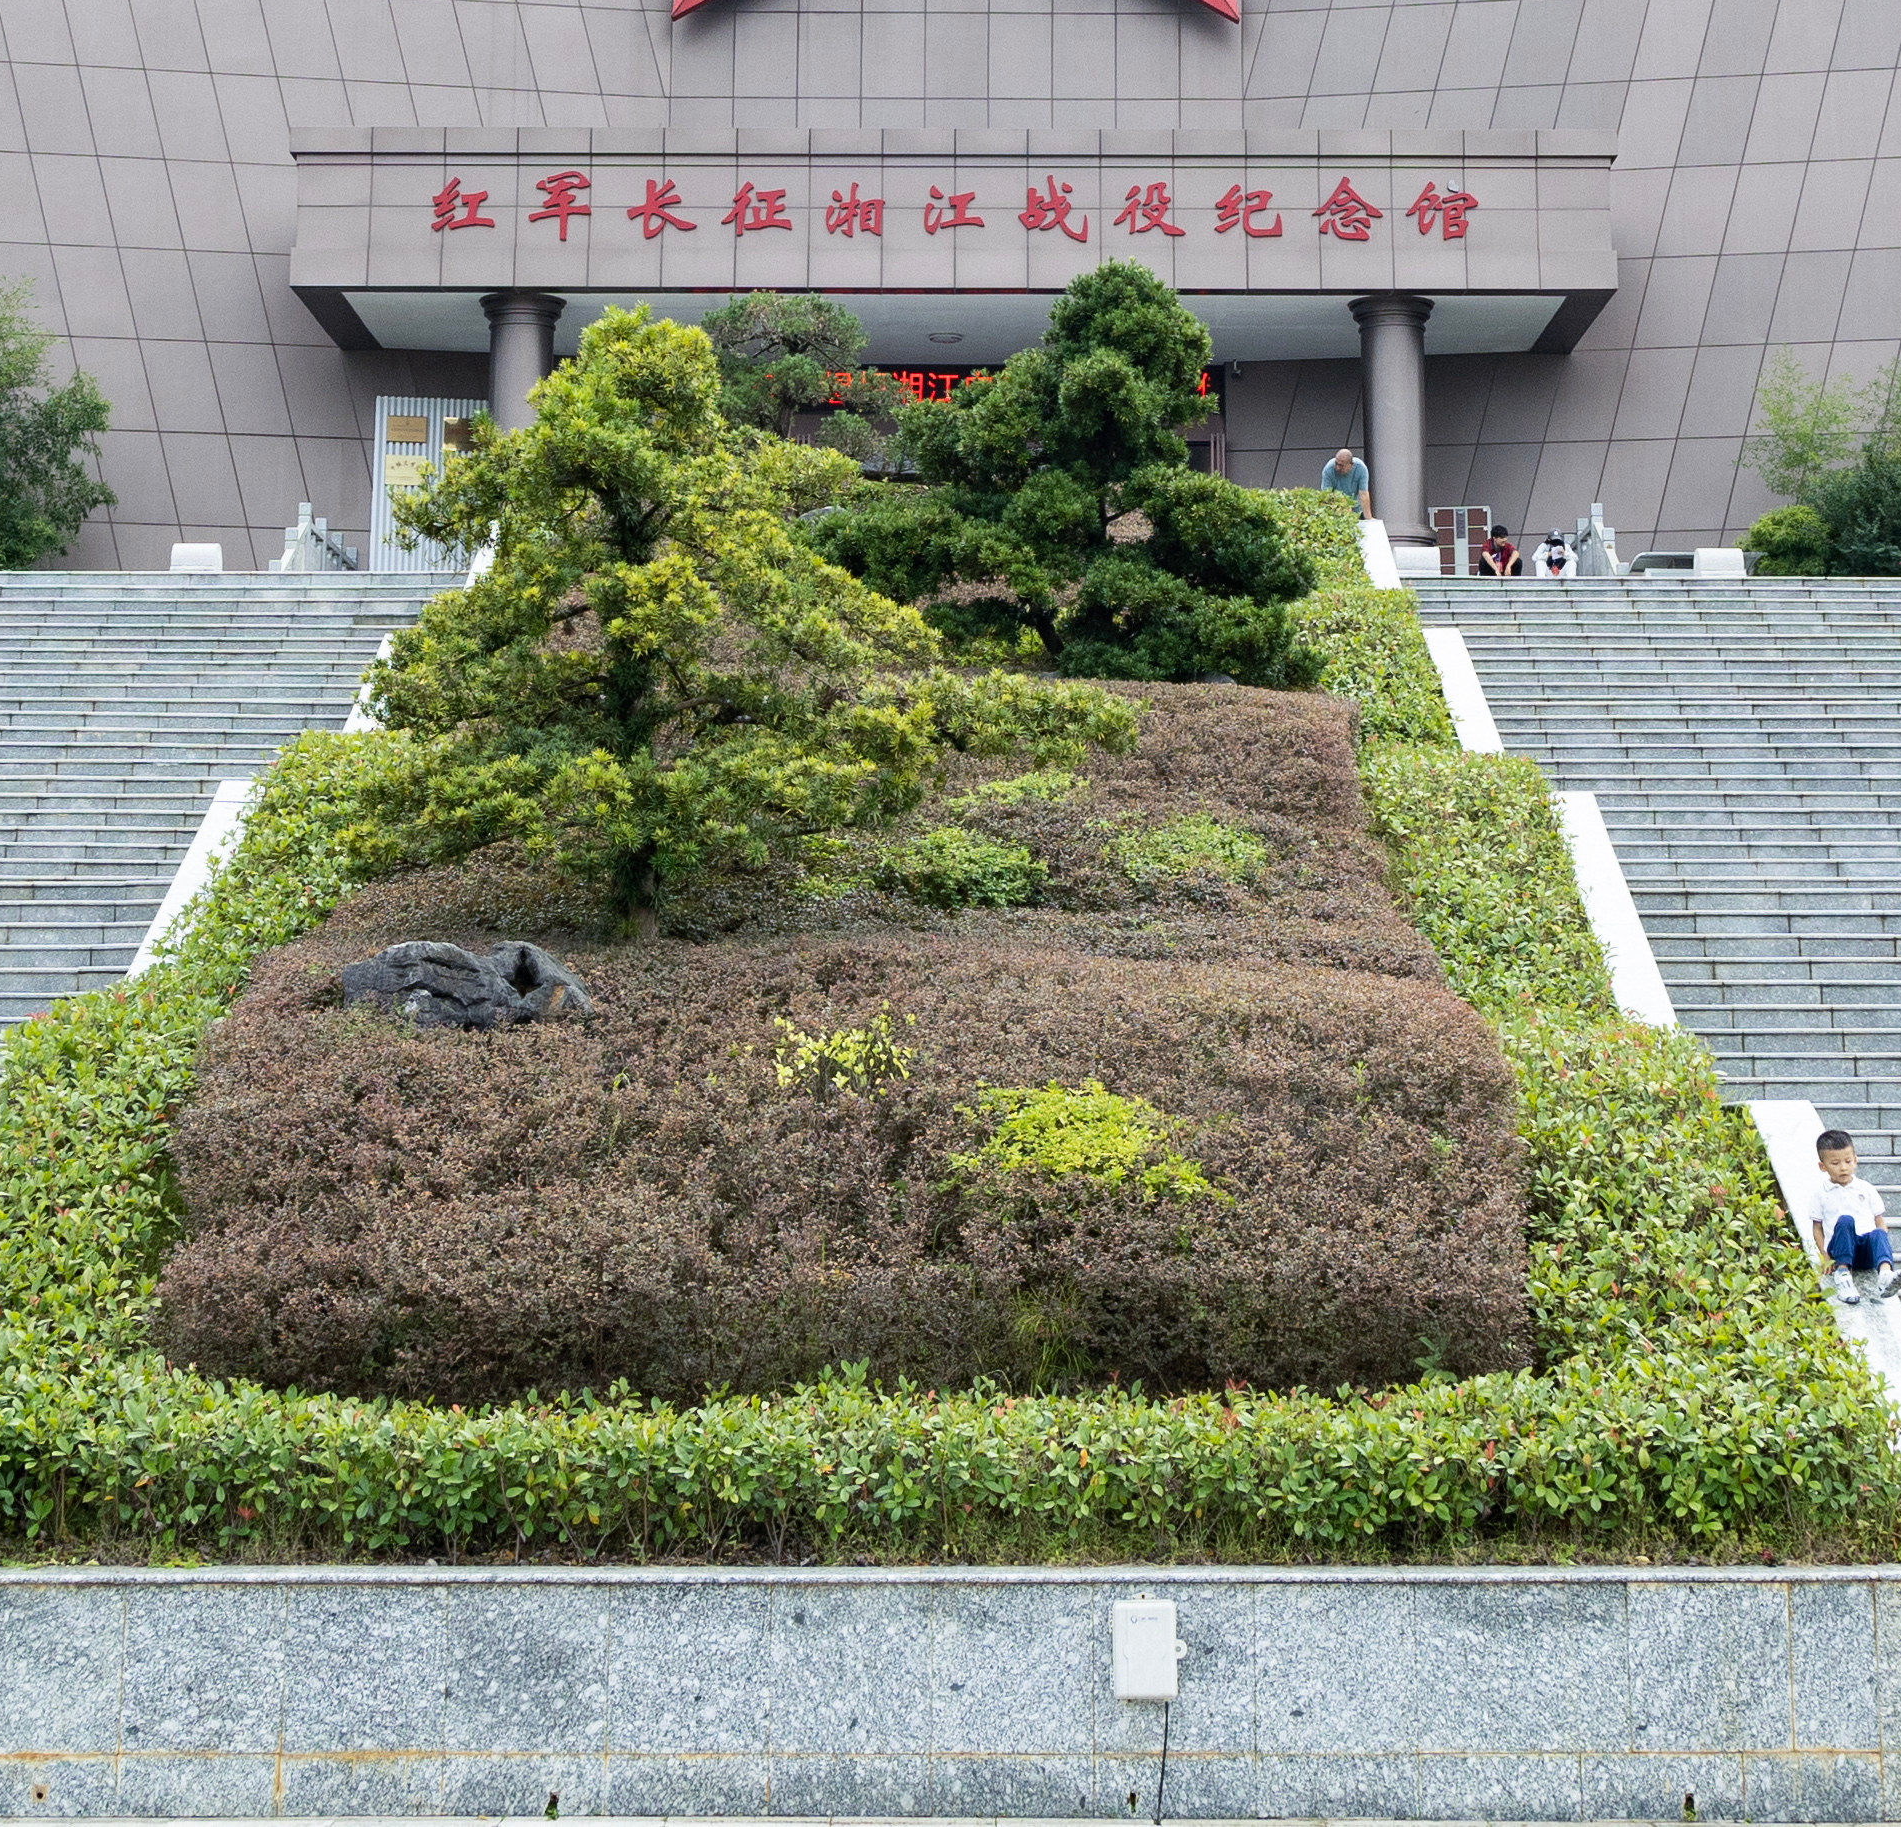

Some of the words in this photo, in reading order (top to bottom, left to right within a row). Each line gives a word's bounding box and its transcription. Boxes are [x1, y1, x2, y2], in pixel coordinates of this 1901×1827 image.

[431, 170, 1479, 242] 红军长征湘江战役纪念馆
